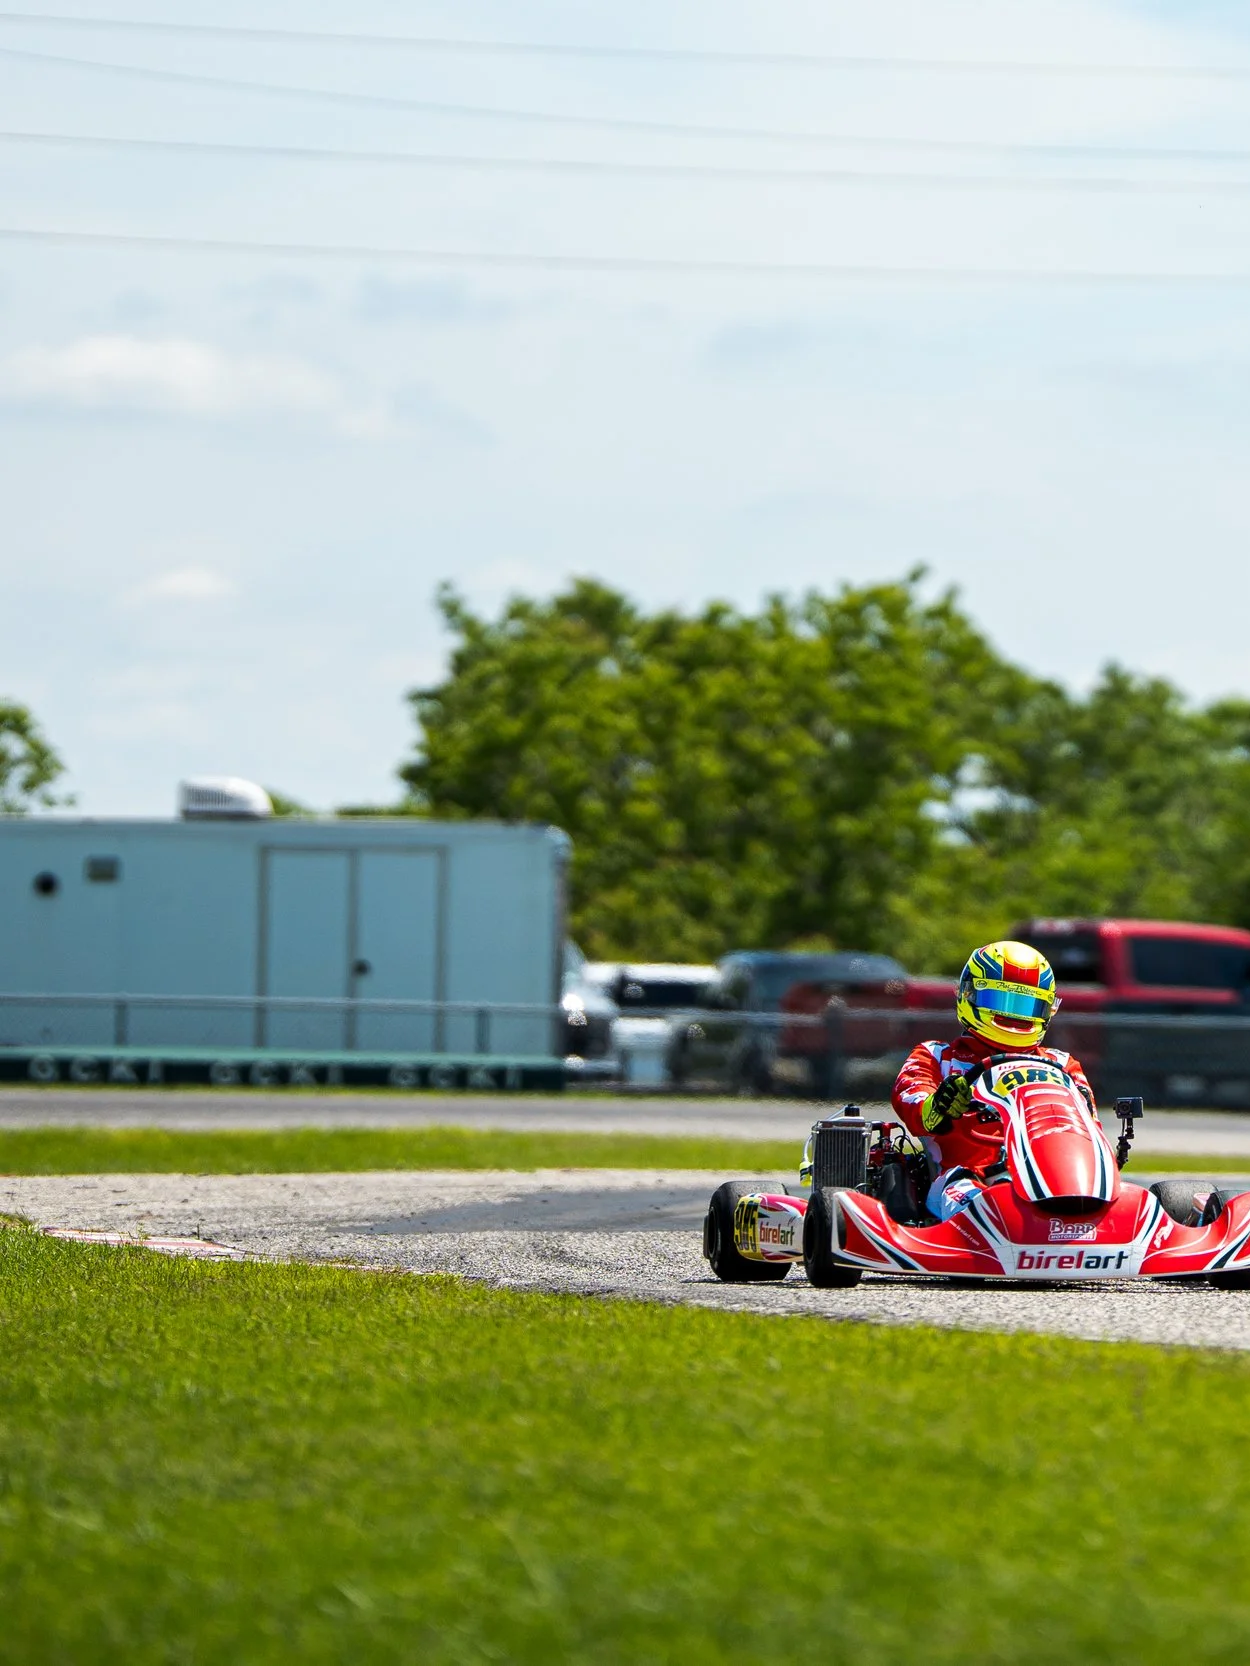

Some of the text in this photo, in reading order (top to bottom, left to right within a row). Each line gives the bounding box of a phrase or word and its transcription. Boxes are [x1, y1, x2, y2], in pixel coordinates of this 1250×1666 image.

[760, 1221, 795, 1246] birelart
[1050, 1218, 1097, 1234] BARP
[1016, 1250, 1129, 1270] birelart
